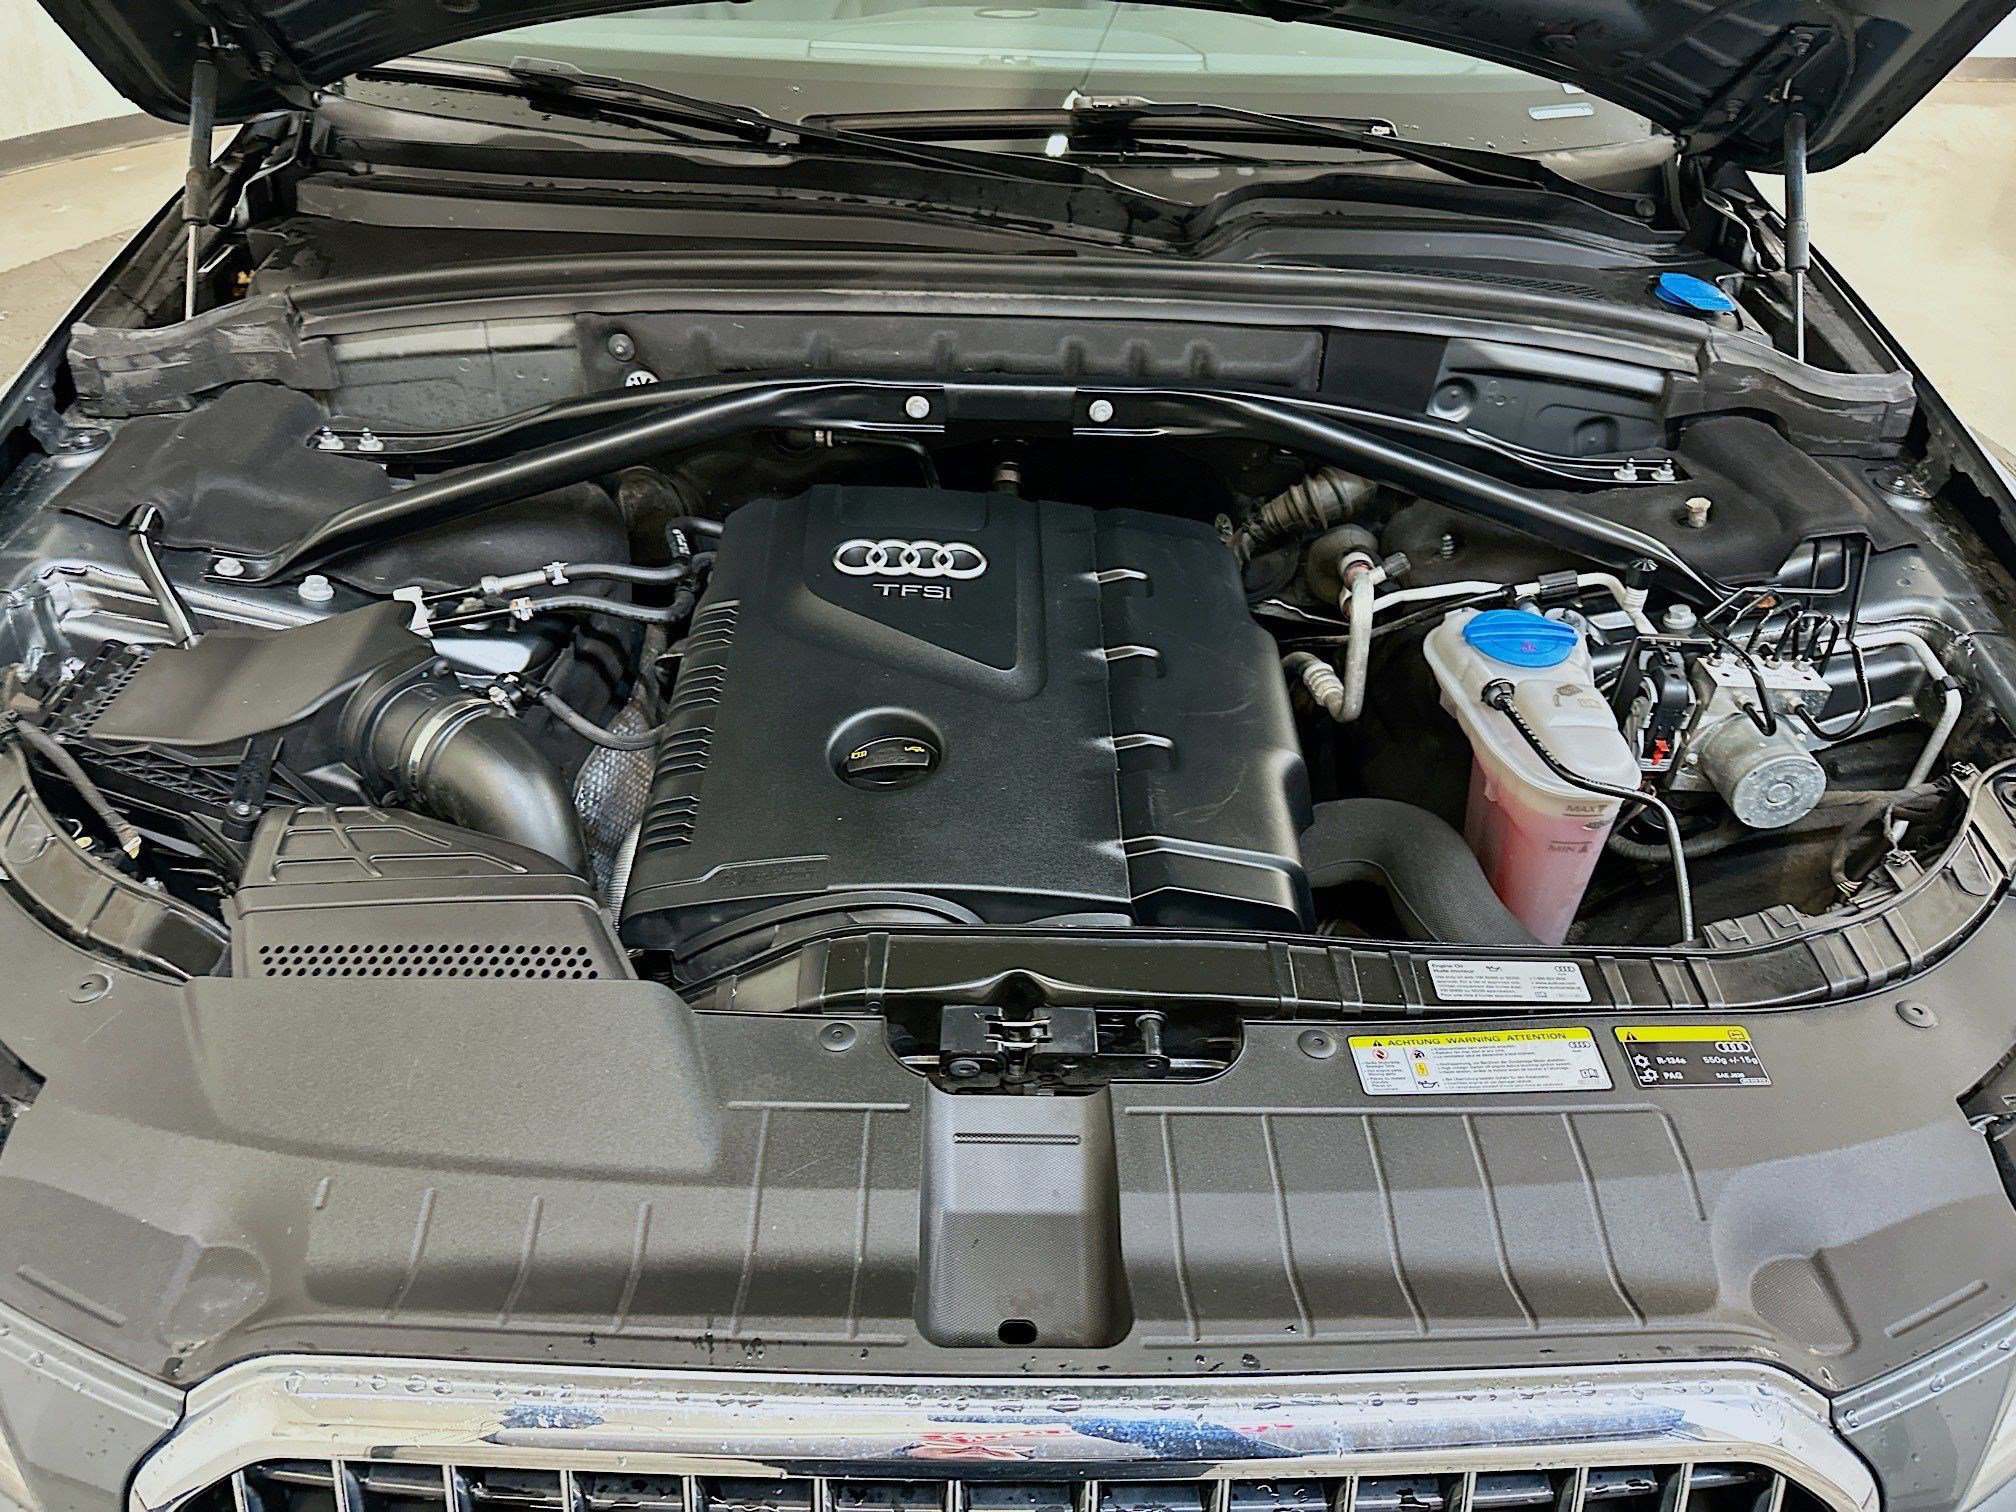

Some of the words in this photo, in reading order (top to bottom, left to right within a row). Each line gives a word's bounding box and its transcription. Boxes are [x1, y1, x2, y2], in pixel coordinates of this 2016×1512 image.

[872, 583, 952, 600] TFSI
[1565, 805, 1596, 813] MAX
[1548, 844, 1577, 853] MIN
[1388, 1038, 1441, 1046] ACHTUNG
[1445, 1035, 1501, 1044] WARNING
[1507, 1033, 1567, 1041] ATTENTION
[1702, 1056, 1728, 1065] 550g
[1662, 1071, 1684, 1080] PAG
